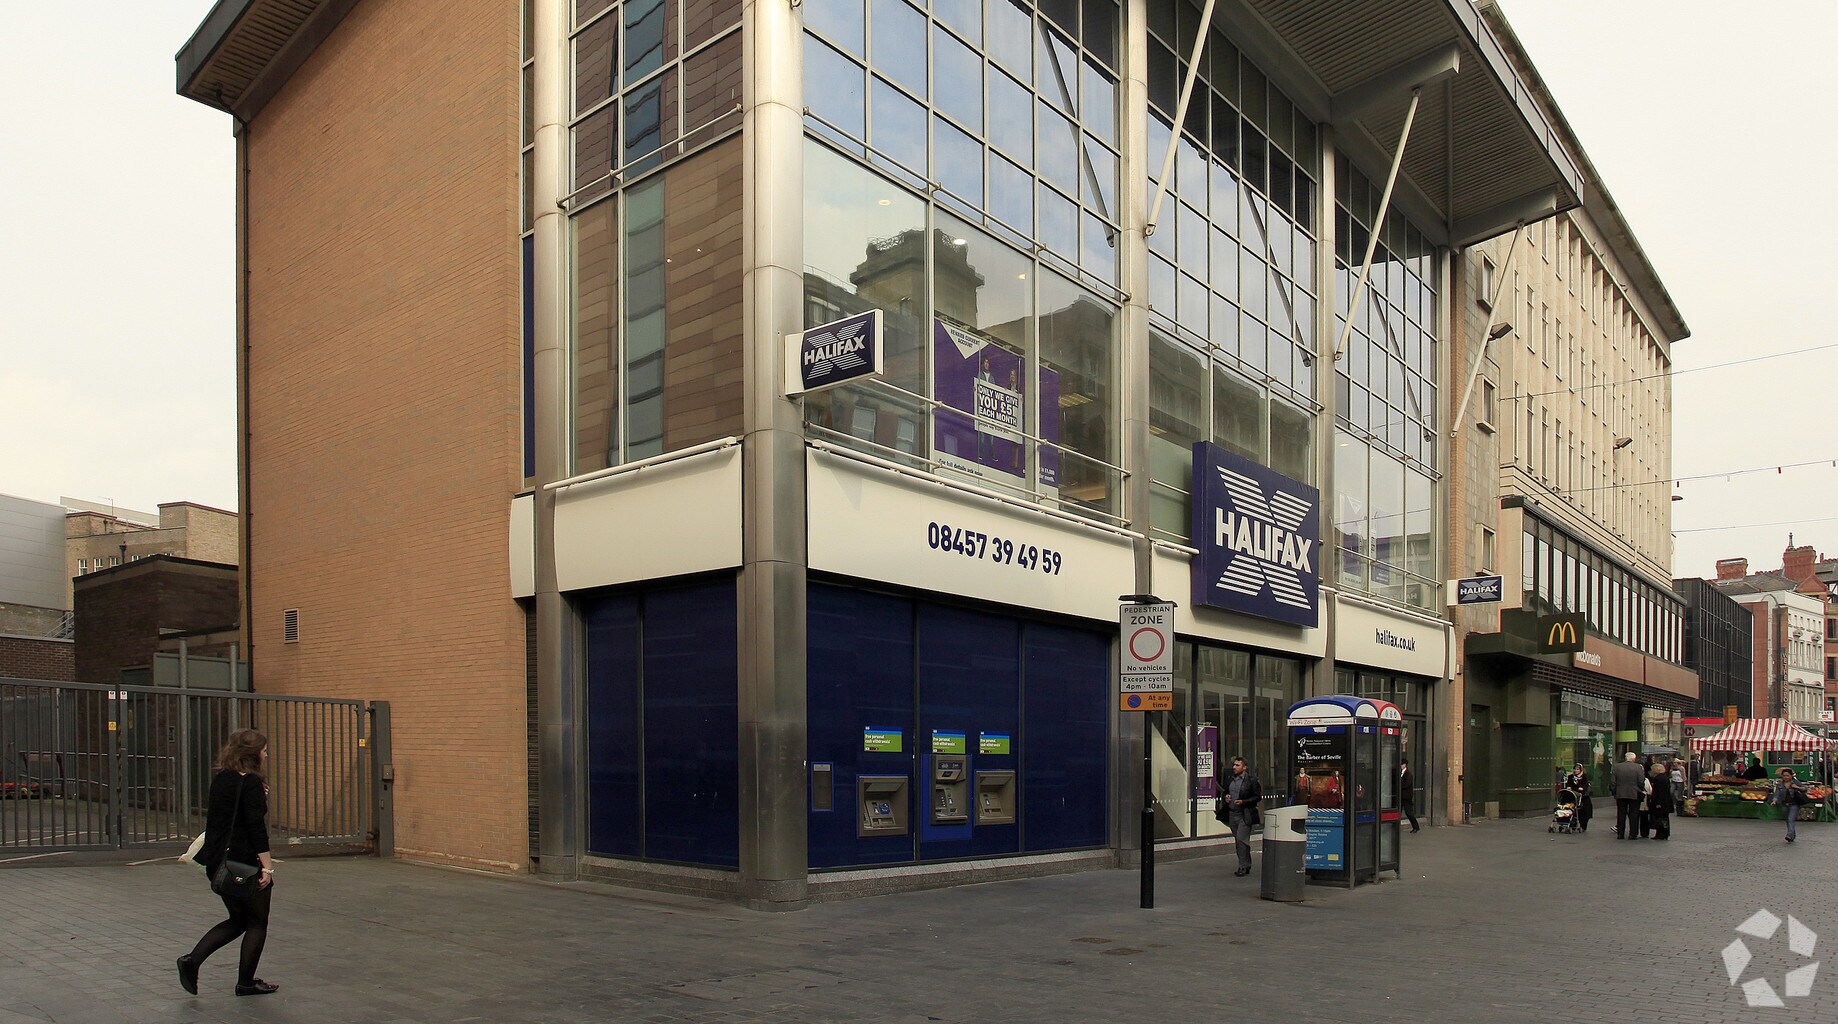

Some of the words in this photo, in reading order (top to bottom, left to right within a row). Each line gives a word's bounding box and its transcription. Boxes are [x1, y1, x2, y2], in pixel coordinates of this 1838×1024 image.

[804, 334, 866, 365] HALIFAX
[978, 385, 994, 397] ONLY
[994, 391, 1005, 401] WE
[1006, 395, 1018, 406] GIVE
[979, 394, 998, 411] YOU
[979, 406, 995, 419] EACH
[996, 412, 1017, 425] MONTH
[928, 521, 987, 559] 08457
[992, 537, 1013, 565] 39
[1017, 543, 1038, 570] 49
[1042, 548, 1062, 575] 59
[1216, 507, 1312, 574] HALIFAX
[1460, 585, 1498, 595] HALIFAX
[1130, 615, 1163, 625] ZONE
[1375, 627, 1416, 652] halifax.co.uk
[1148, 676, 1170, 684] cycles
